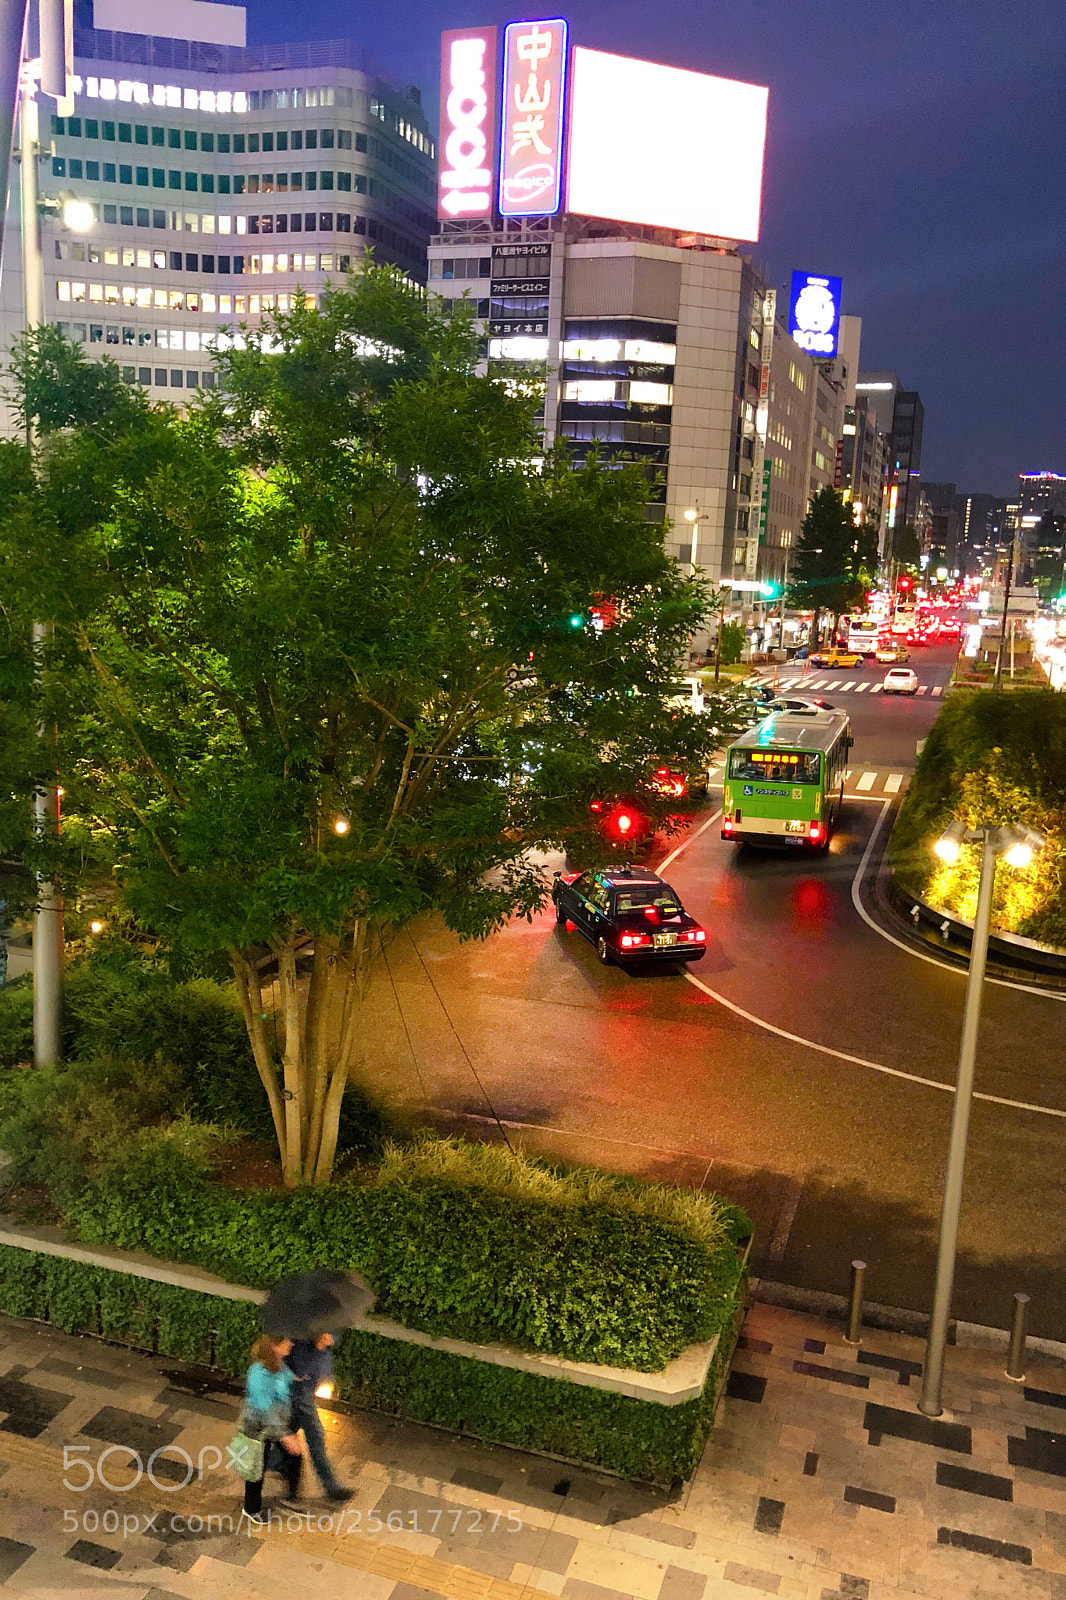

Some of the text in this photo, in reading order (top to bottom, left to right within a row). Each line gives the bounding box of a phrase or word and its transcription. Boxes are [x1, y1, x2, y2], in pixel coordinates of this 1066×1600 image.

[510, 25, 552, 156] 中山式
[493, 324, 544, 333] ヤヨイ本店
